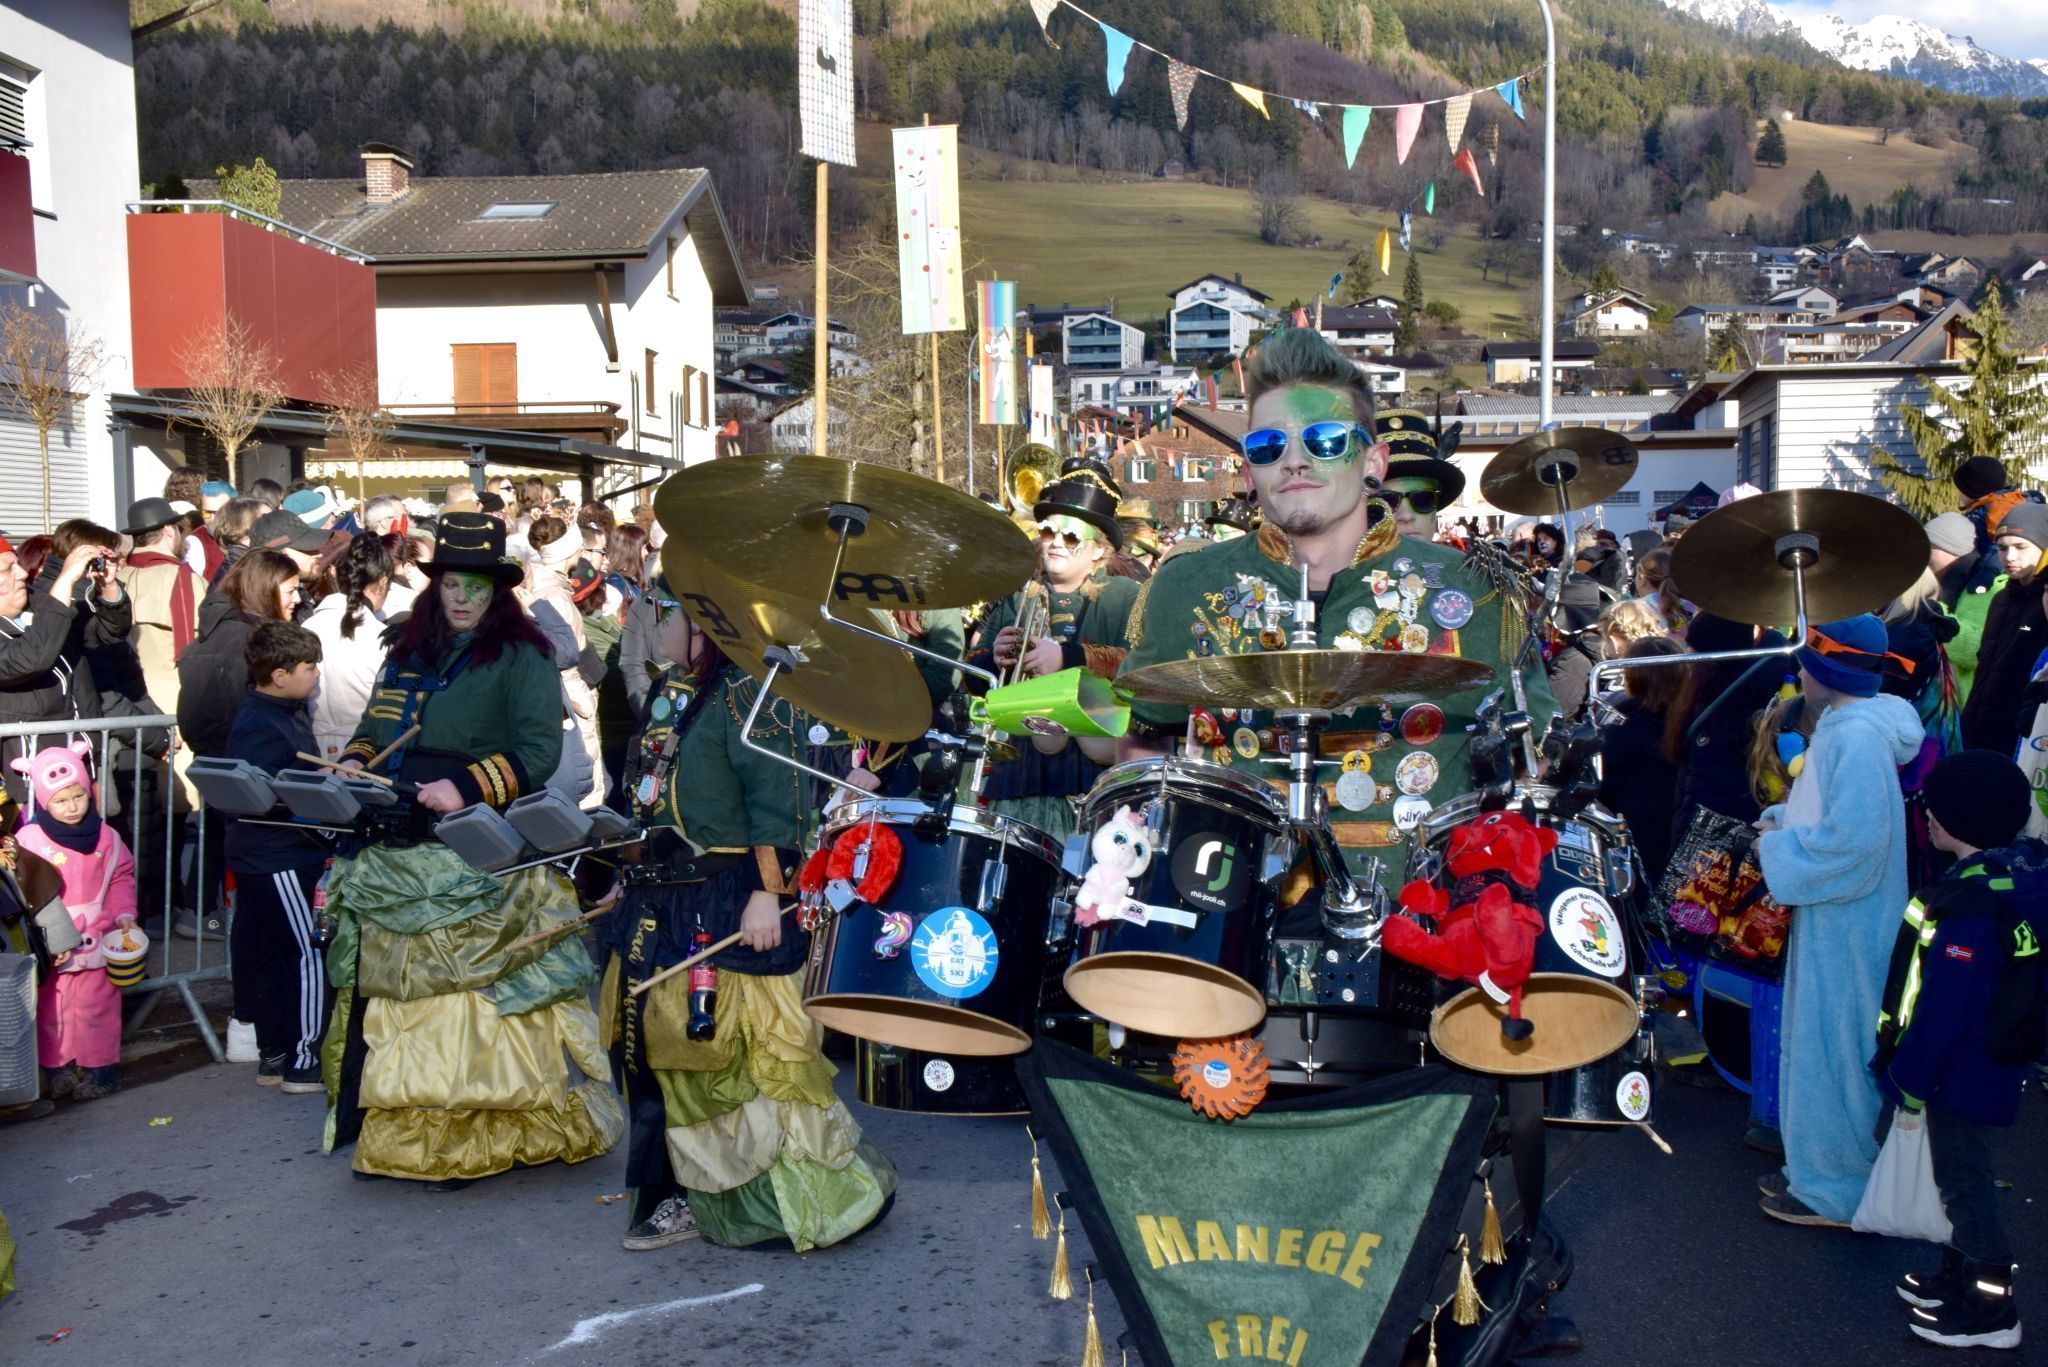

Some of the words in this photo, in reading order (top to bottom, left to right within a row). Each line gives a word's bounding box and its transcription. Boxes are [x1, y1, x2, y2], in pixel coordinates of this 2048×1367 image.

[1195, 840, 1235, 892] rj
[950, 969, 965, 977] SKI
[1135, 1214, 1382, 1289] MANEGE
[1208, 1314, 1309, 1367] FREI
